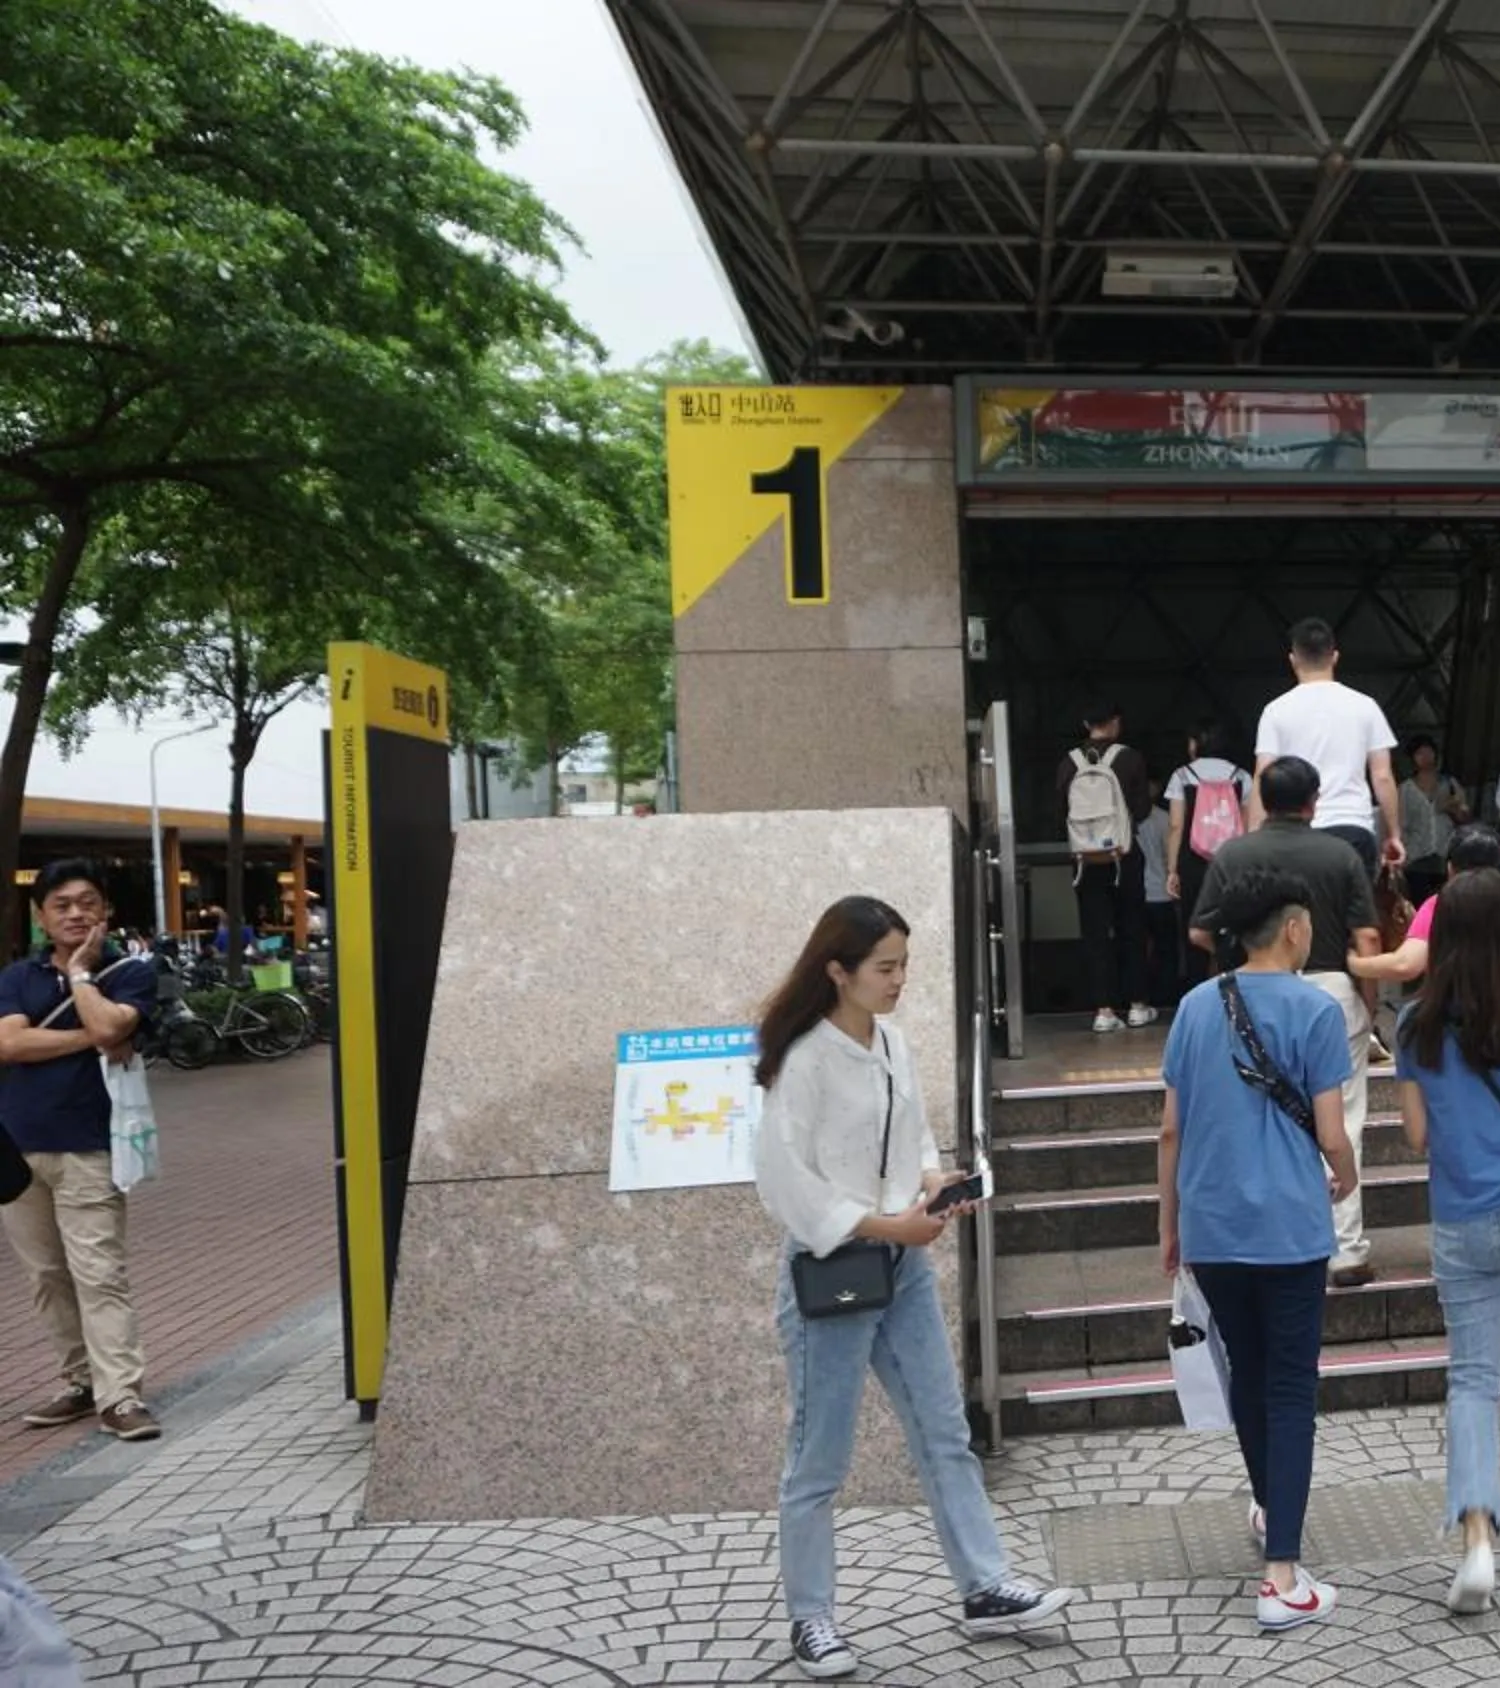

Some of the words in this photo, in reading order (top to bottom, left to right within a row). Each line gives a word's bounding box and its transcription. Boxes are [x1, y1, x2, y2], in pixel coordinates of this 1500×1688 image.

[680, 392, 721, 417] 出入口
[731, 391, 795, 413] 中山站
[751, 446, 824, 599] 1
